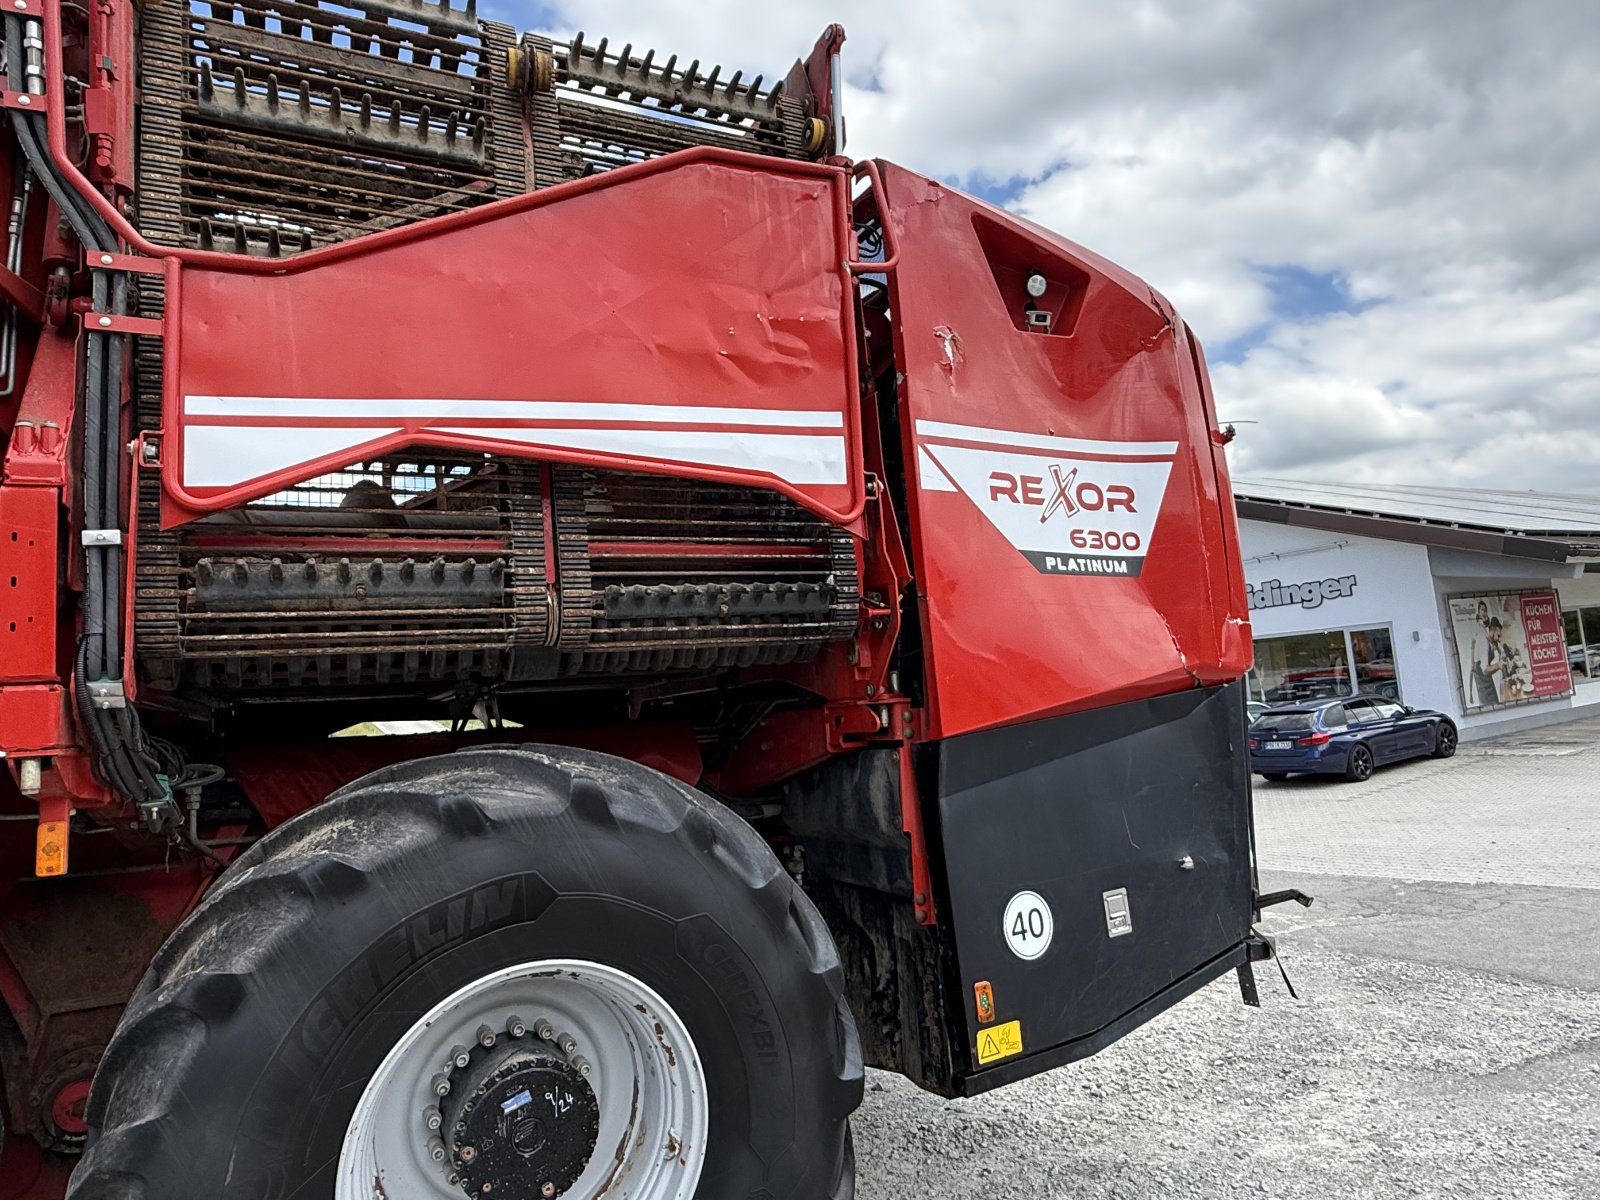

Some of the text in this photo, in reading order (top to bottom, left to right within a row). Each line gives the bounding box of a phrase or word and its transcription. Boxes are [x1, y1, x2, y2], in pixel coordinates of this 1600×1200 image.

[989, 464, 1137, 524] REXOR
[1069, 529, 1141, 551] 6300
[1045, 557, 1128, 573] PLATINUM
[1525, 603, 1553, 616] KÜCHEN
[1527, 618, 1541, 631] FÜR
[1530, 632, 1560, 645] MEISTER-
[1532, 646, 1558, 660] KÖCHE!
[1012, 908, 1044, 941] 40
[246, 879, 518, 1135] ICHELIN
[545, 1085, 574, 1118] 9/24
